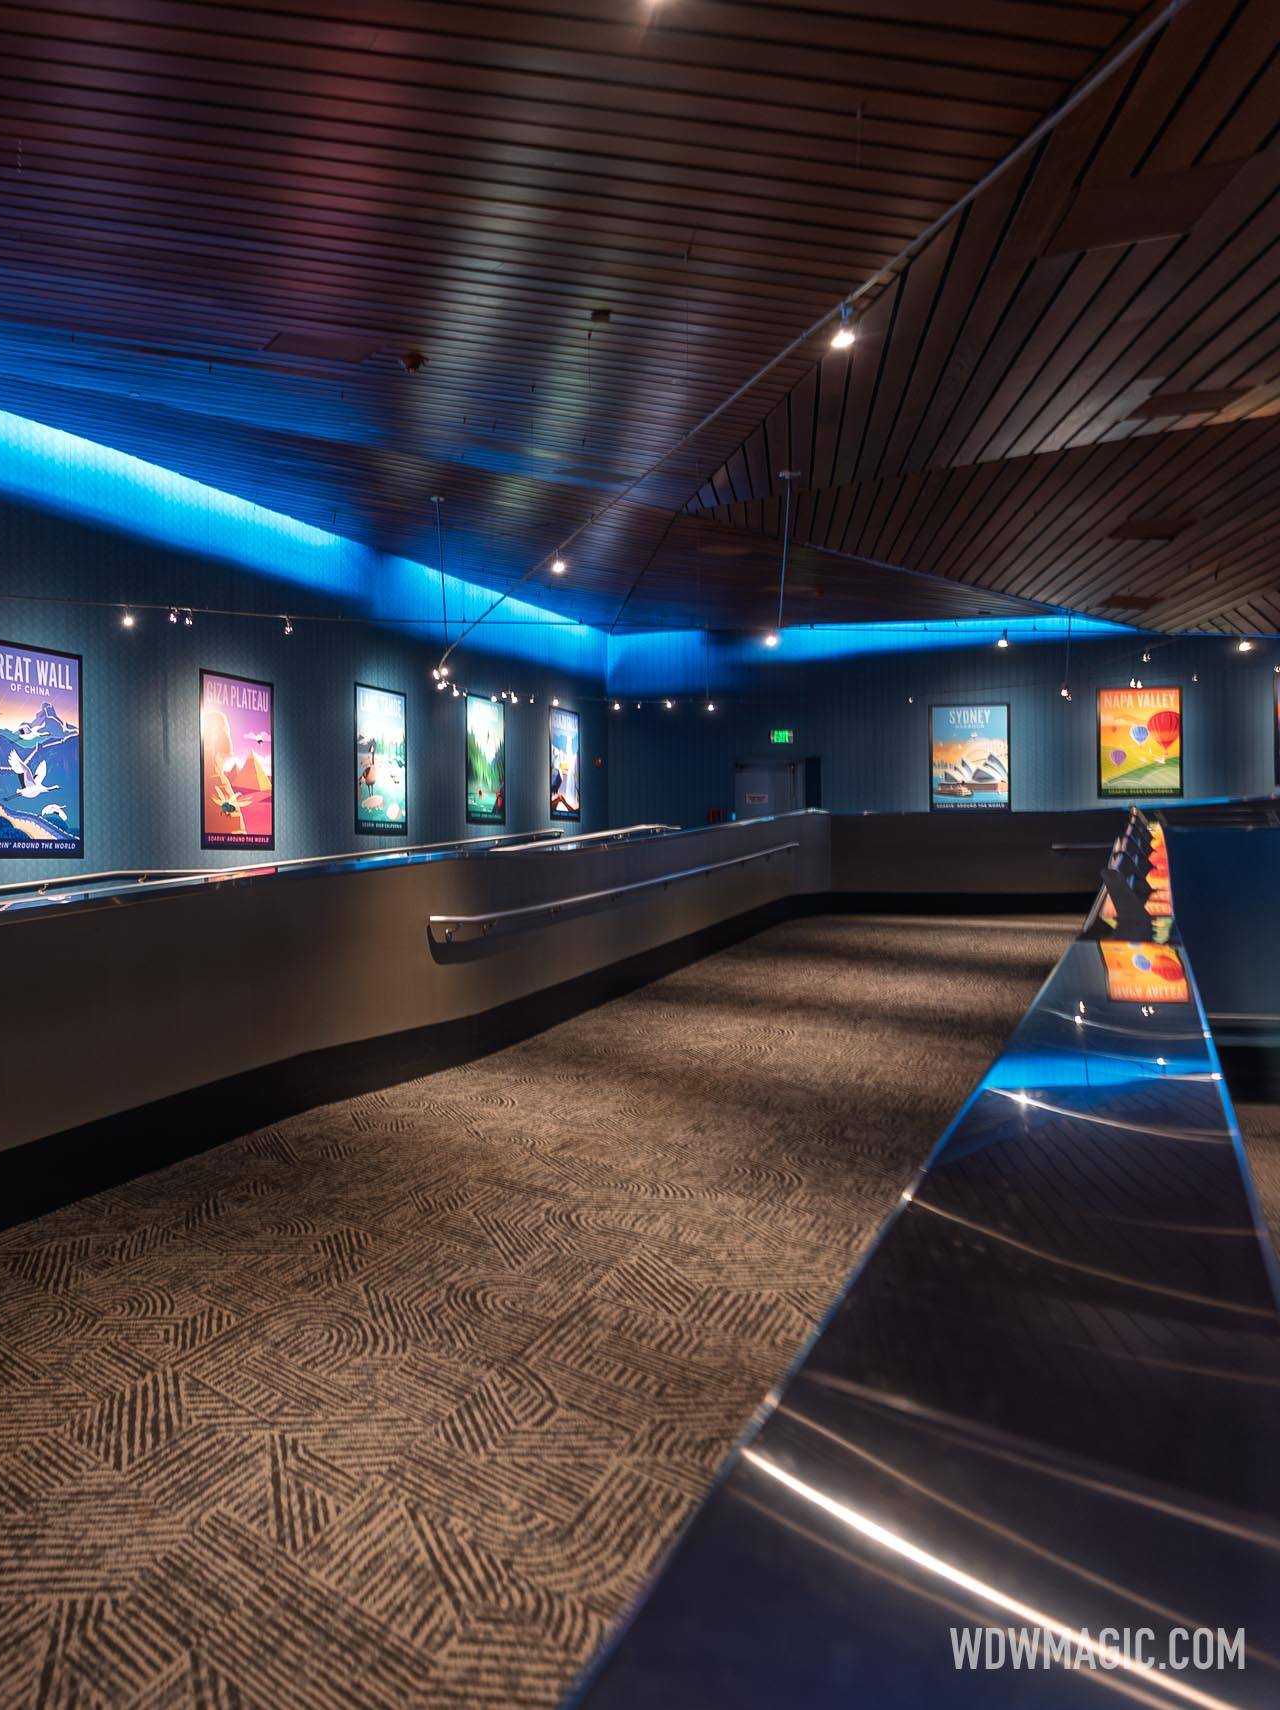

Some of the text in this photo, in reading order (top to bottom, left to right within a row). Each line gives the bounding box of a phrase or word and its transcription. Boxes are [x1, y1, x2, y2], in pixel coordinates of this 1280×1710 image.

[36, 659, 73, 690] WALL
[10, 683, 50, 696] OF CHINA
[206, 681, 269, 713] GIZA PLATEAU
[1104, 691, 1175, 709] NAPA VALLEY
[949, 708, 991, 724] SYDNEY
[12, 841, 40, 849] AROUND
